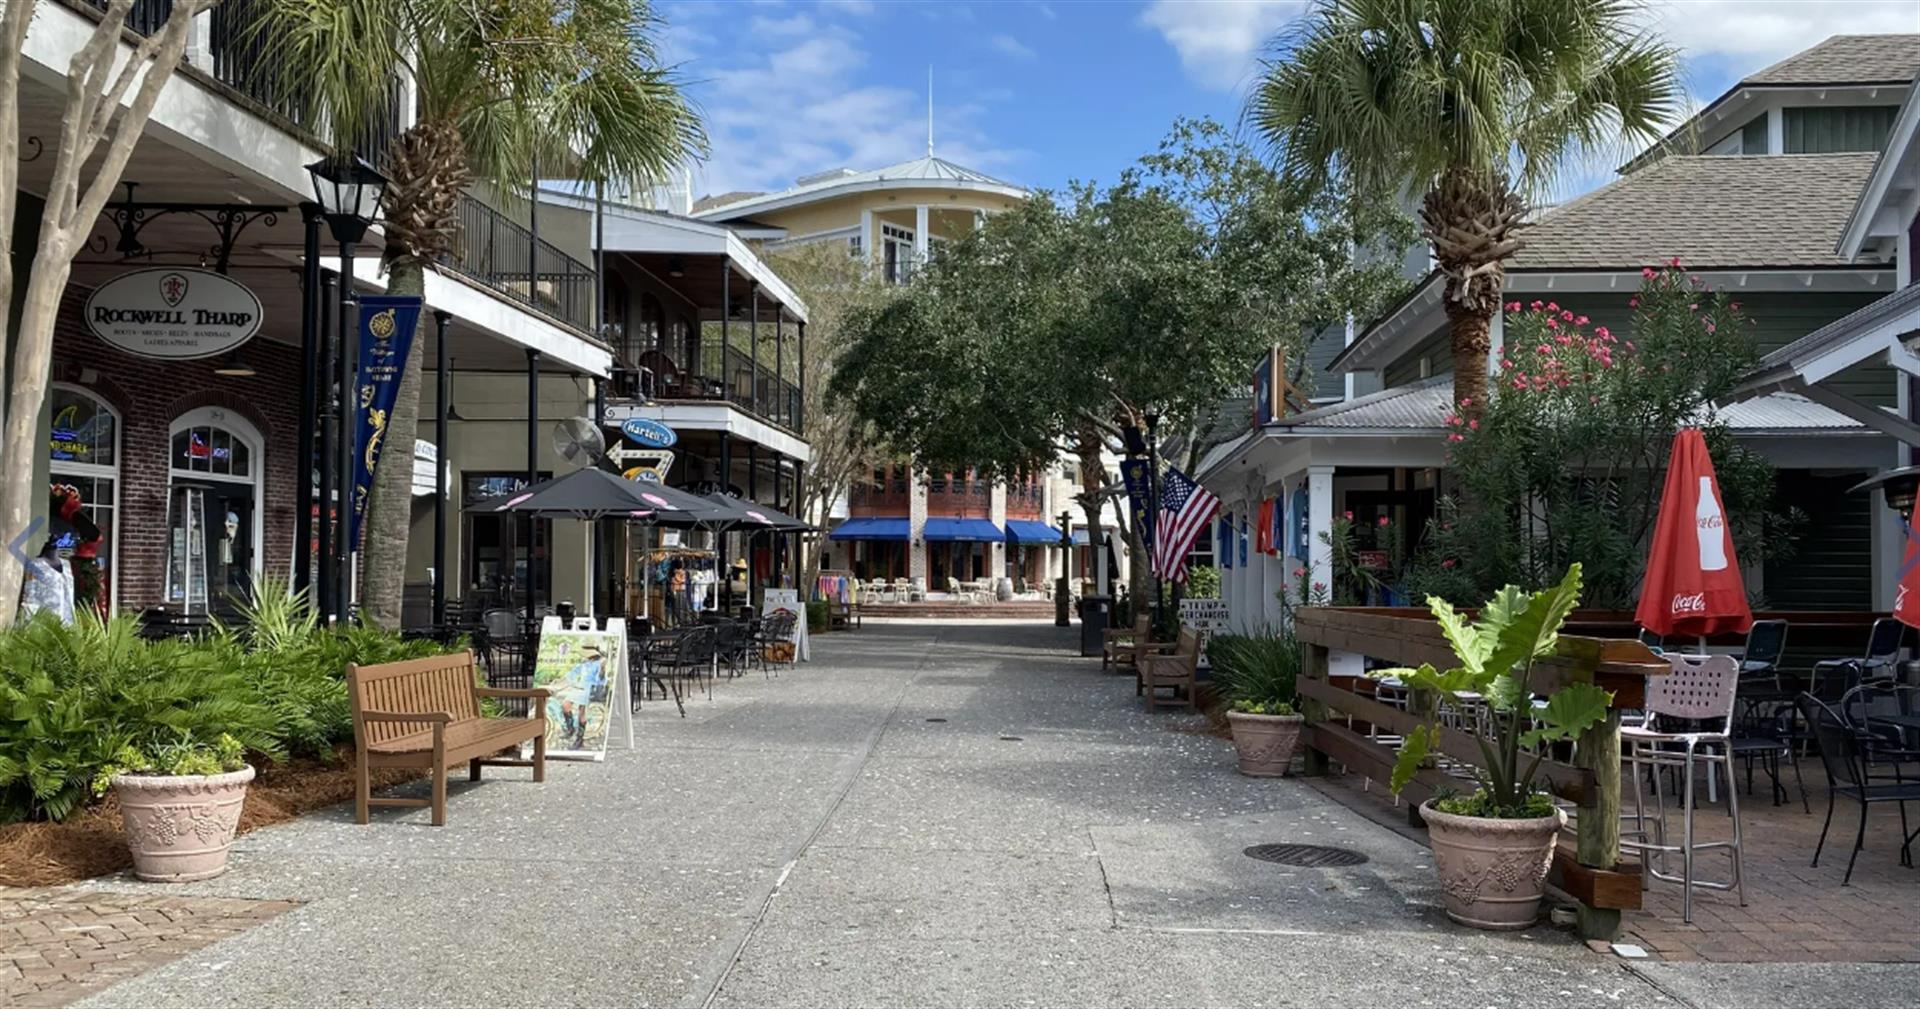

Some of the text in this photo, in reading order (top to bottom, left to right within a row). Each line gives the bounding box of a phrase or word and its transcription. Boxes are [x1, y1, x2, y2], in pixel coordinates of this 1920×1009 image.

[94, 306, 252, 328] ROCKWELL THARP
[1189, 601, 1218, 609] TRUMP
